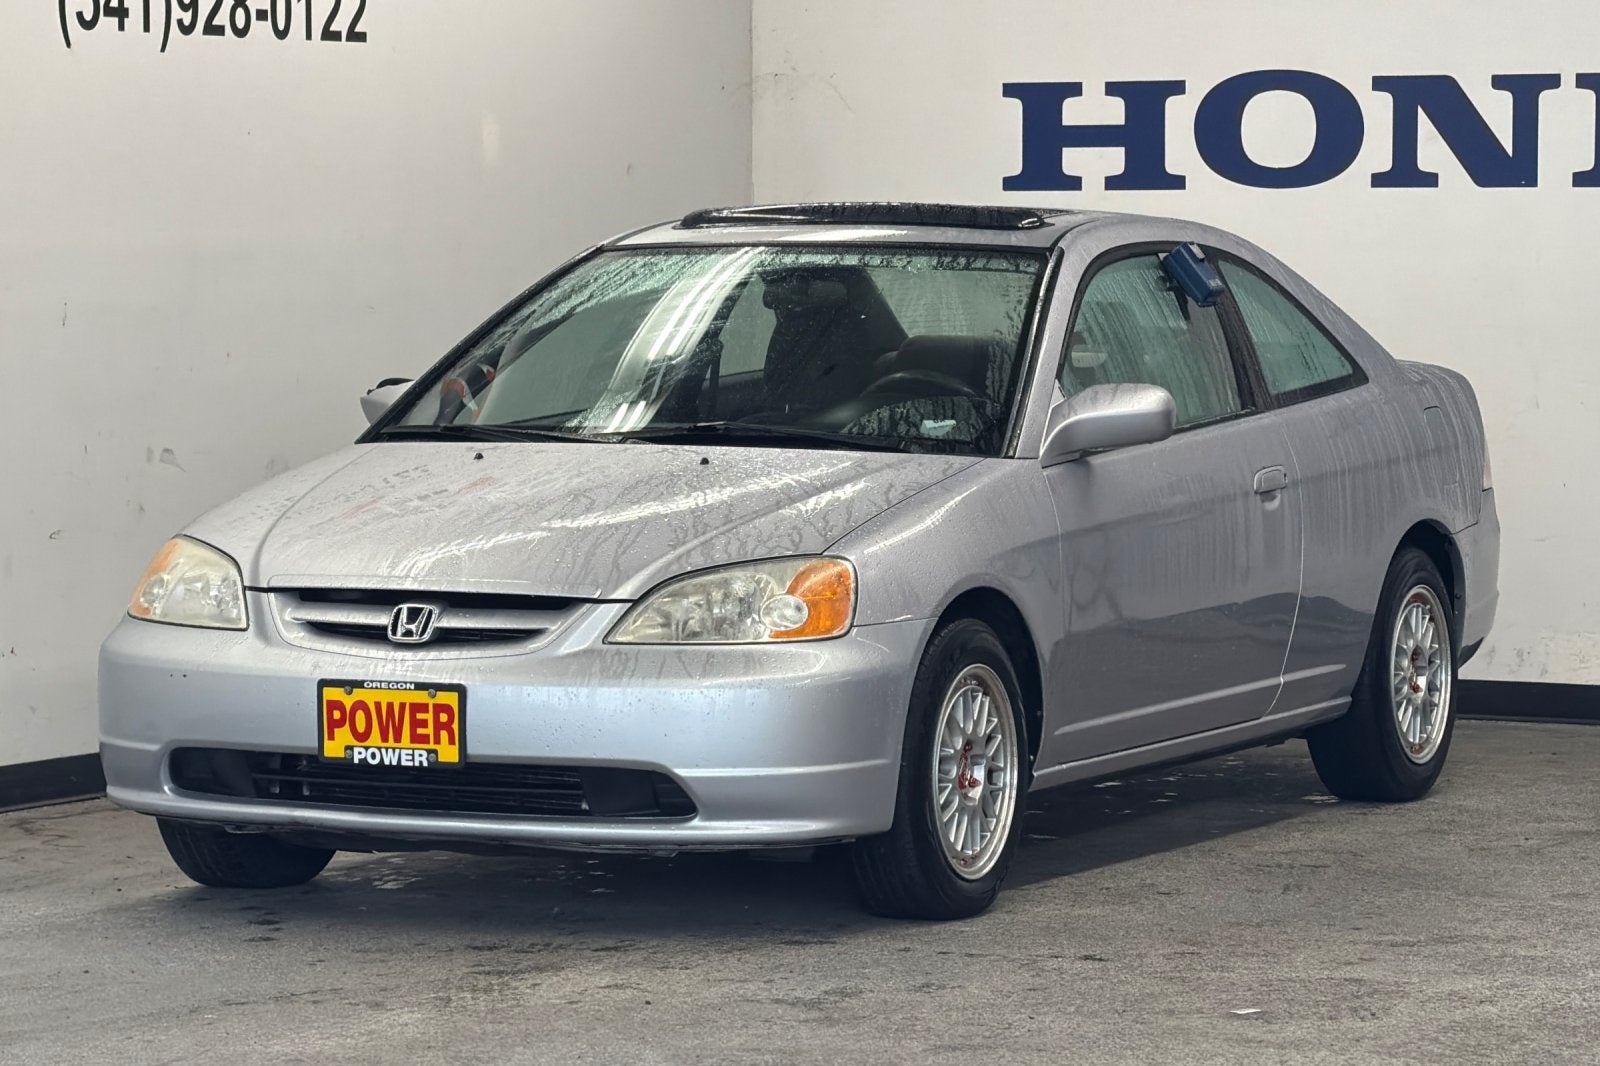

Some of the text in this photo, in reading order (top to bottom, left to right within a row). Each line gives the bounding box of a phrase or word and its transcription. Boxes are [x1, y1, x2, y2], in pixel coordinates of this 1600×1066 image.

[1002, 69, 1600, 191] HON
[363, 681, 415, 690] OREGON
[326, 699, 456, 746] POWER
[353, 747, 429, 767] POWER
